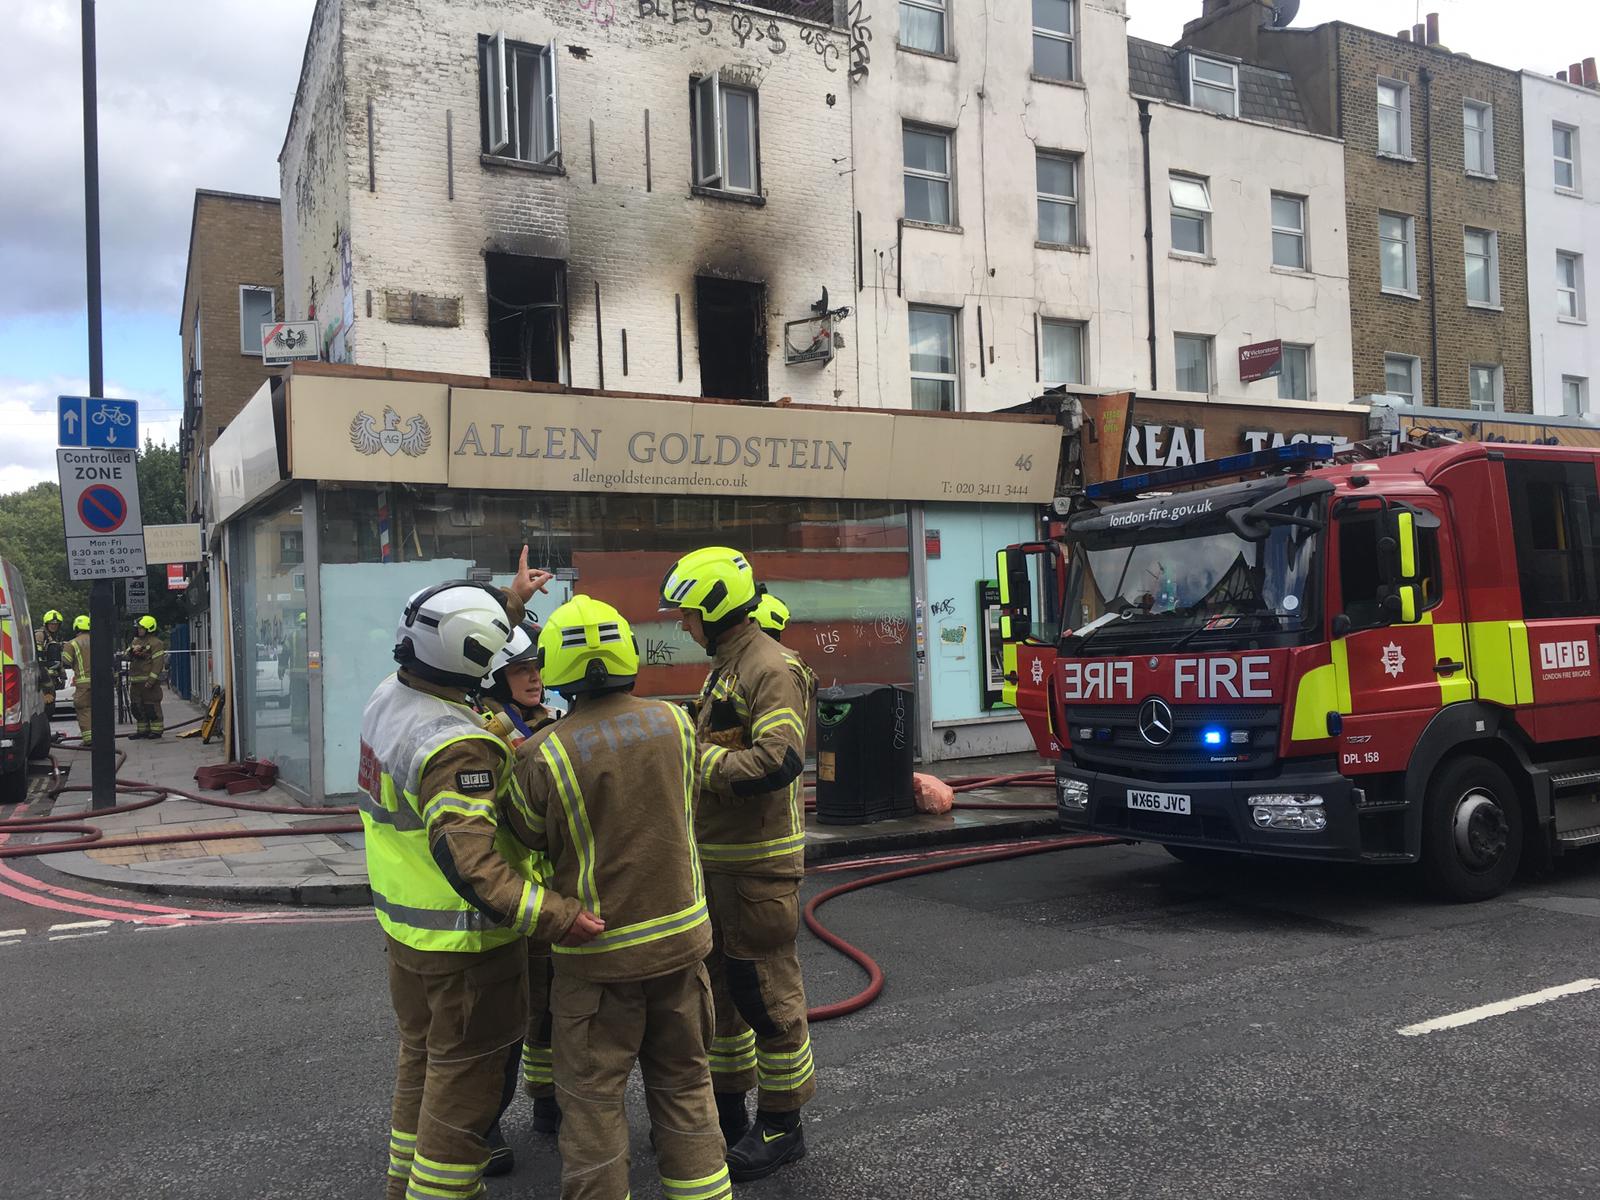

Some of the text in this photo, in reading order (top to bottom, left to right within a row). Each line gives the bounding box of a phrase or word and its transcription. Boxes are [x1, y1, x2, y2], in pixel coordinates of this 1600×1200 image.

[384, 434, 399, 444] AG
[454, 422, 852, 471] ALLEN GOLDSTEIN
[64, 453, 131, 463] Controlled
[1014, 454, 1033, 471] 46
[75, 467, 122, 479] ZONE
[572, 467, 748, 489] allengoldsteincamden.co.uk
[956, 483, 974, 494] 020
[978, 483, 1001, 495] 3411
[1004, 484, 1029, 496] 3444
[1109, 499, 1213, 527] london-fire.gov.uk
[1544, 644, 1586, 665] LFB
[1175, 656, 1273, 698] FIRE
[1542, 672, 1562, 680] LONDON
[571, 706, 674, 764] FIRE
[1343, 751, 1380, 764] DPL 158
[1163, 796, 1186, 811] JVC
